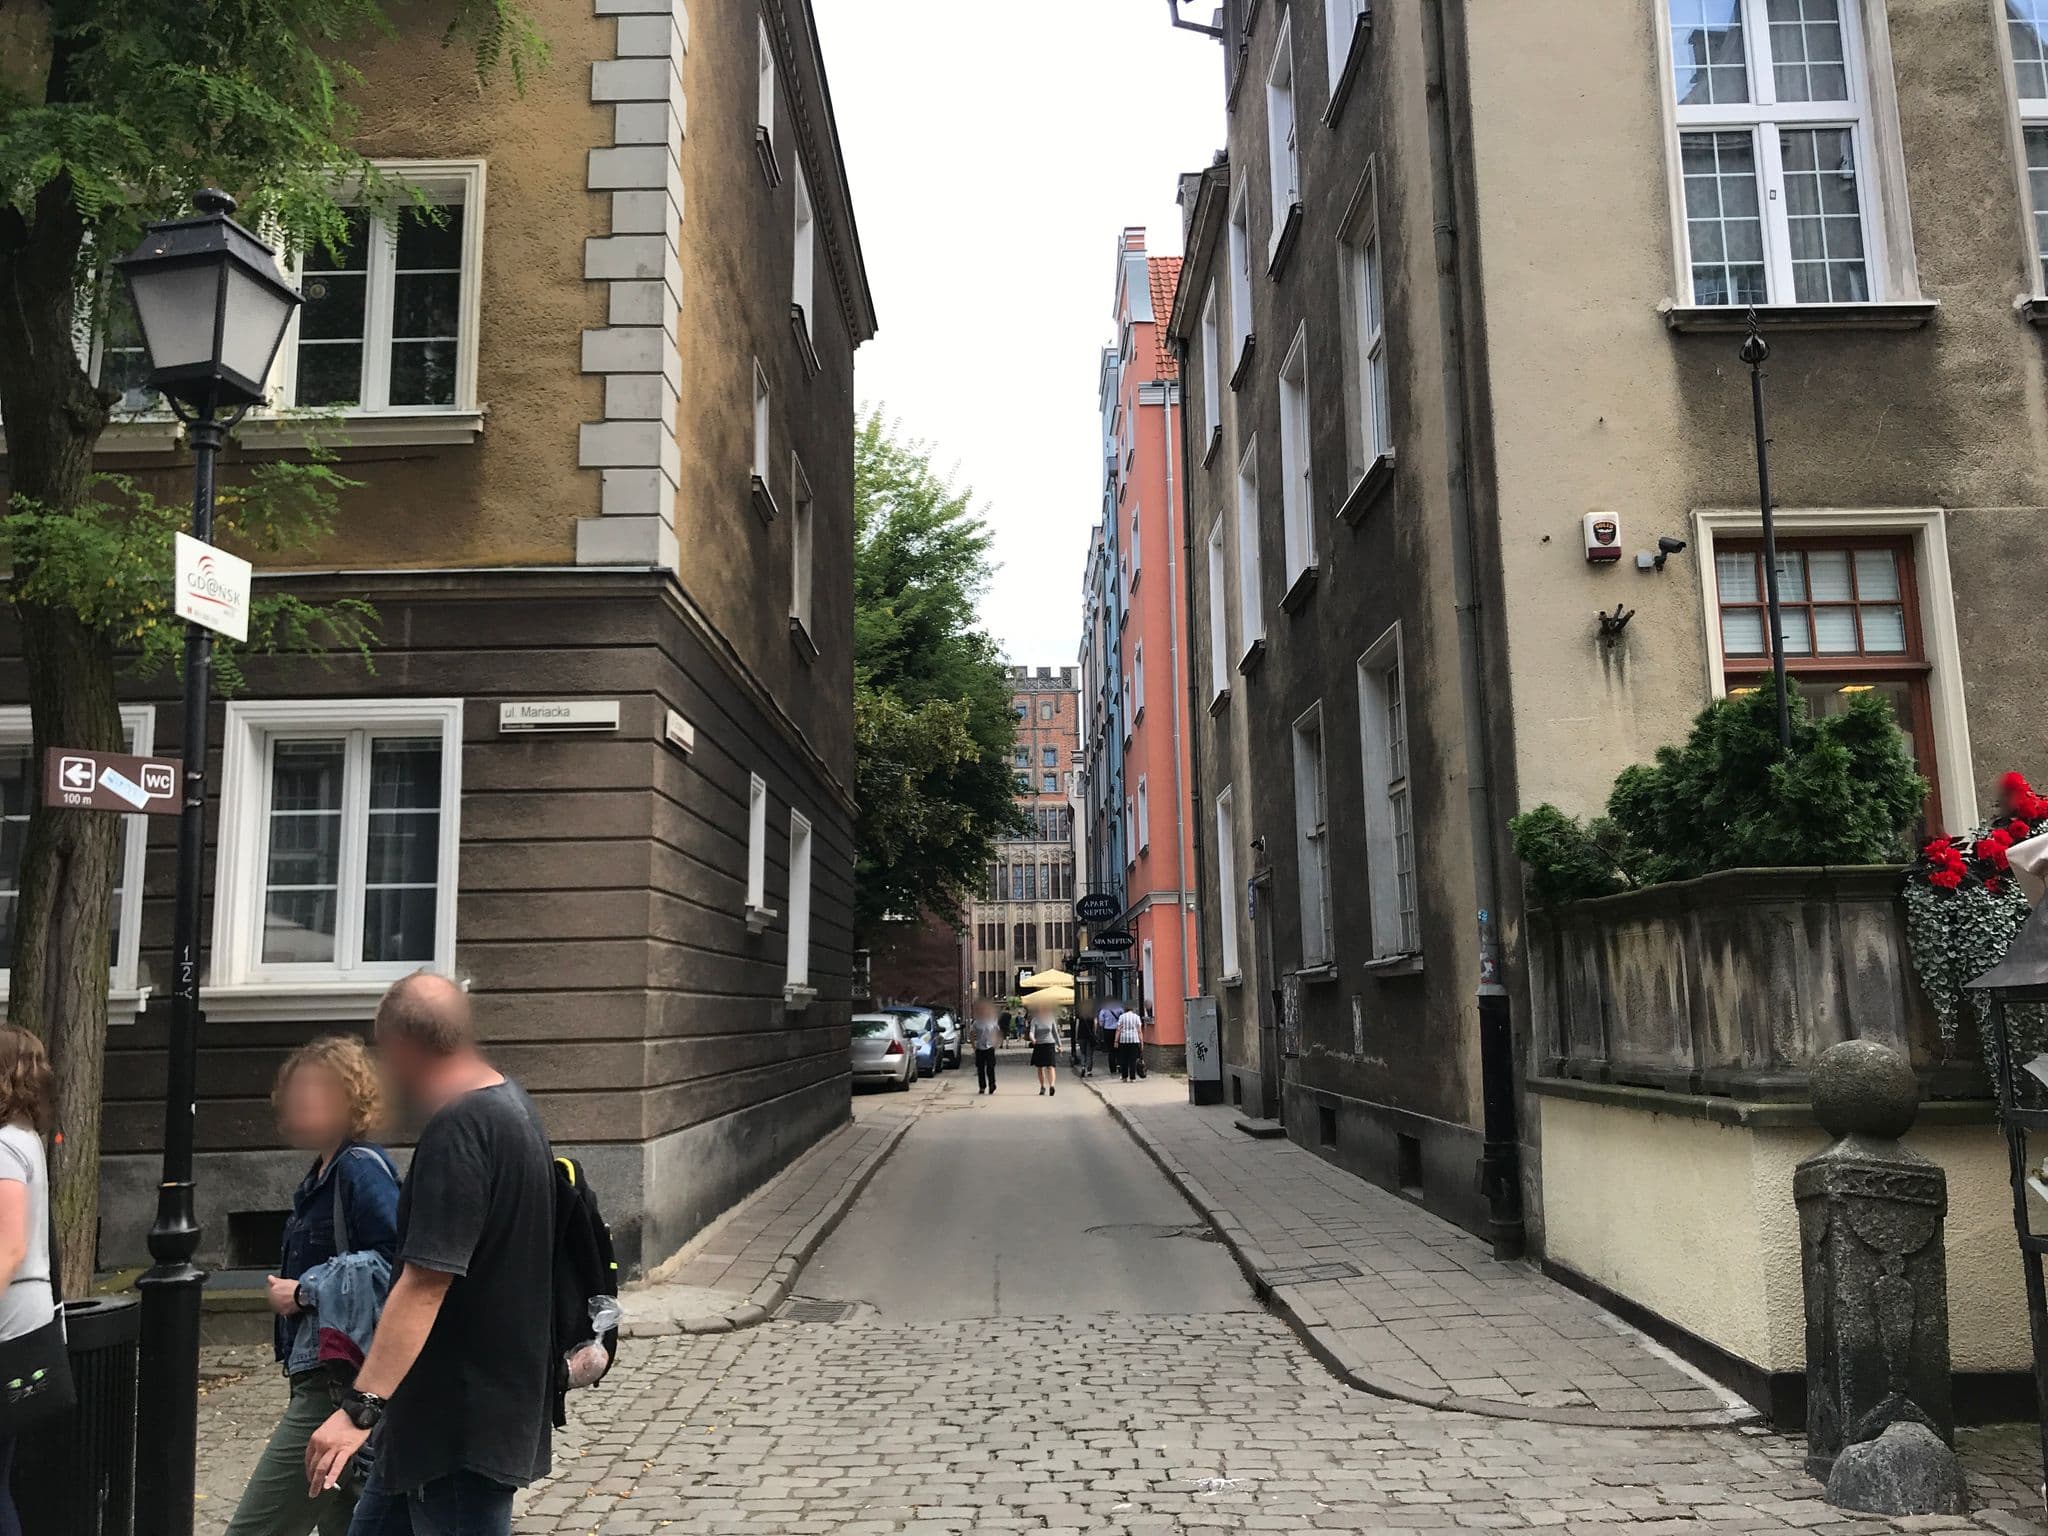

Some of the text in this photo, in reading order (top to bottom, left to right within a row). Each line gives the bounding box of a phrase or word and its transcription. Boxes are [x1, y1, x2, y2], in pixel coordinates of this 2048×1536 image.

[504, 704, 571, 718] ul. Mariacka
[146, 773, 170, 789] WC
[63, 792, 92, 805] 100 m
[1084, 900, 1109, 908] APART
[1083, 908, 1114, 916] NEPTUN
[1094, 936, 1133, 946] SPA NEPTUN
